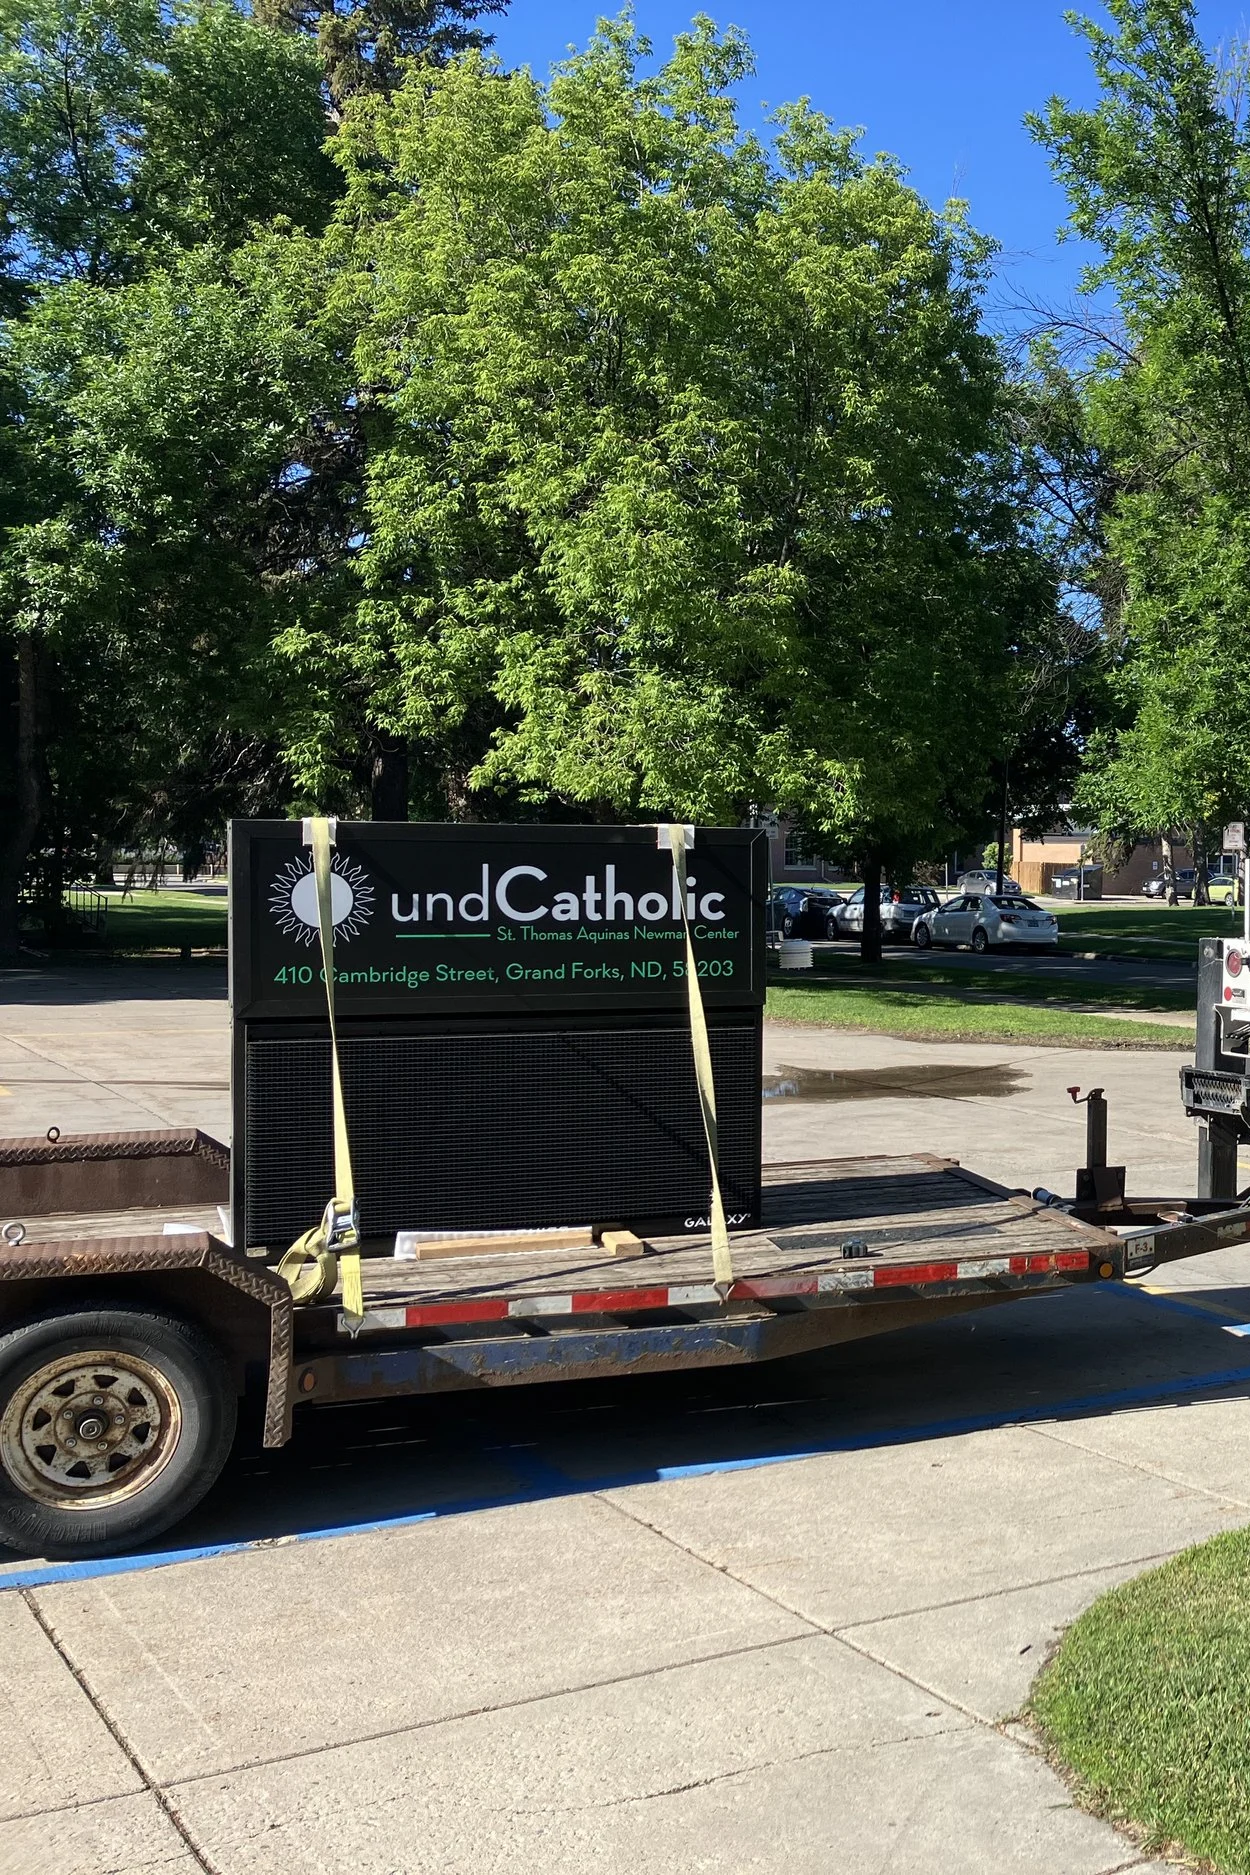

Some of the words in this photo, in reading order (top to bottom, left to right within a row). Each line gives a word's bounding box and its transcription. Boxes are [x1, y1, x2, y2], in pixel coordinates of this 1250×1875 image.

[391, 863, 726, 922] undCatholic
[497, 926, 516, 941] St.
[520, 925, 573, 941] Thomas
[577, 926, 630, 944] Aquinas
[694, 925, 740, 939] Center
[274, 966, 313, 984] 410
[320, 965, 430, 989] Cambridge
[435, 964, 500, 984] Street,
[505, 962, 565, 980] Grand
[571, 962, 625, 981] Forks,
[631, 961, 667, 980] ND,
[684, 1213, 748, 1228] GALXY
